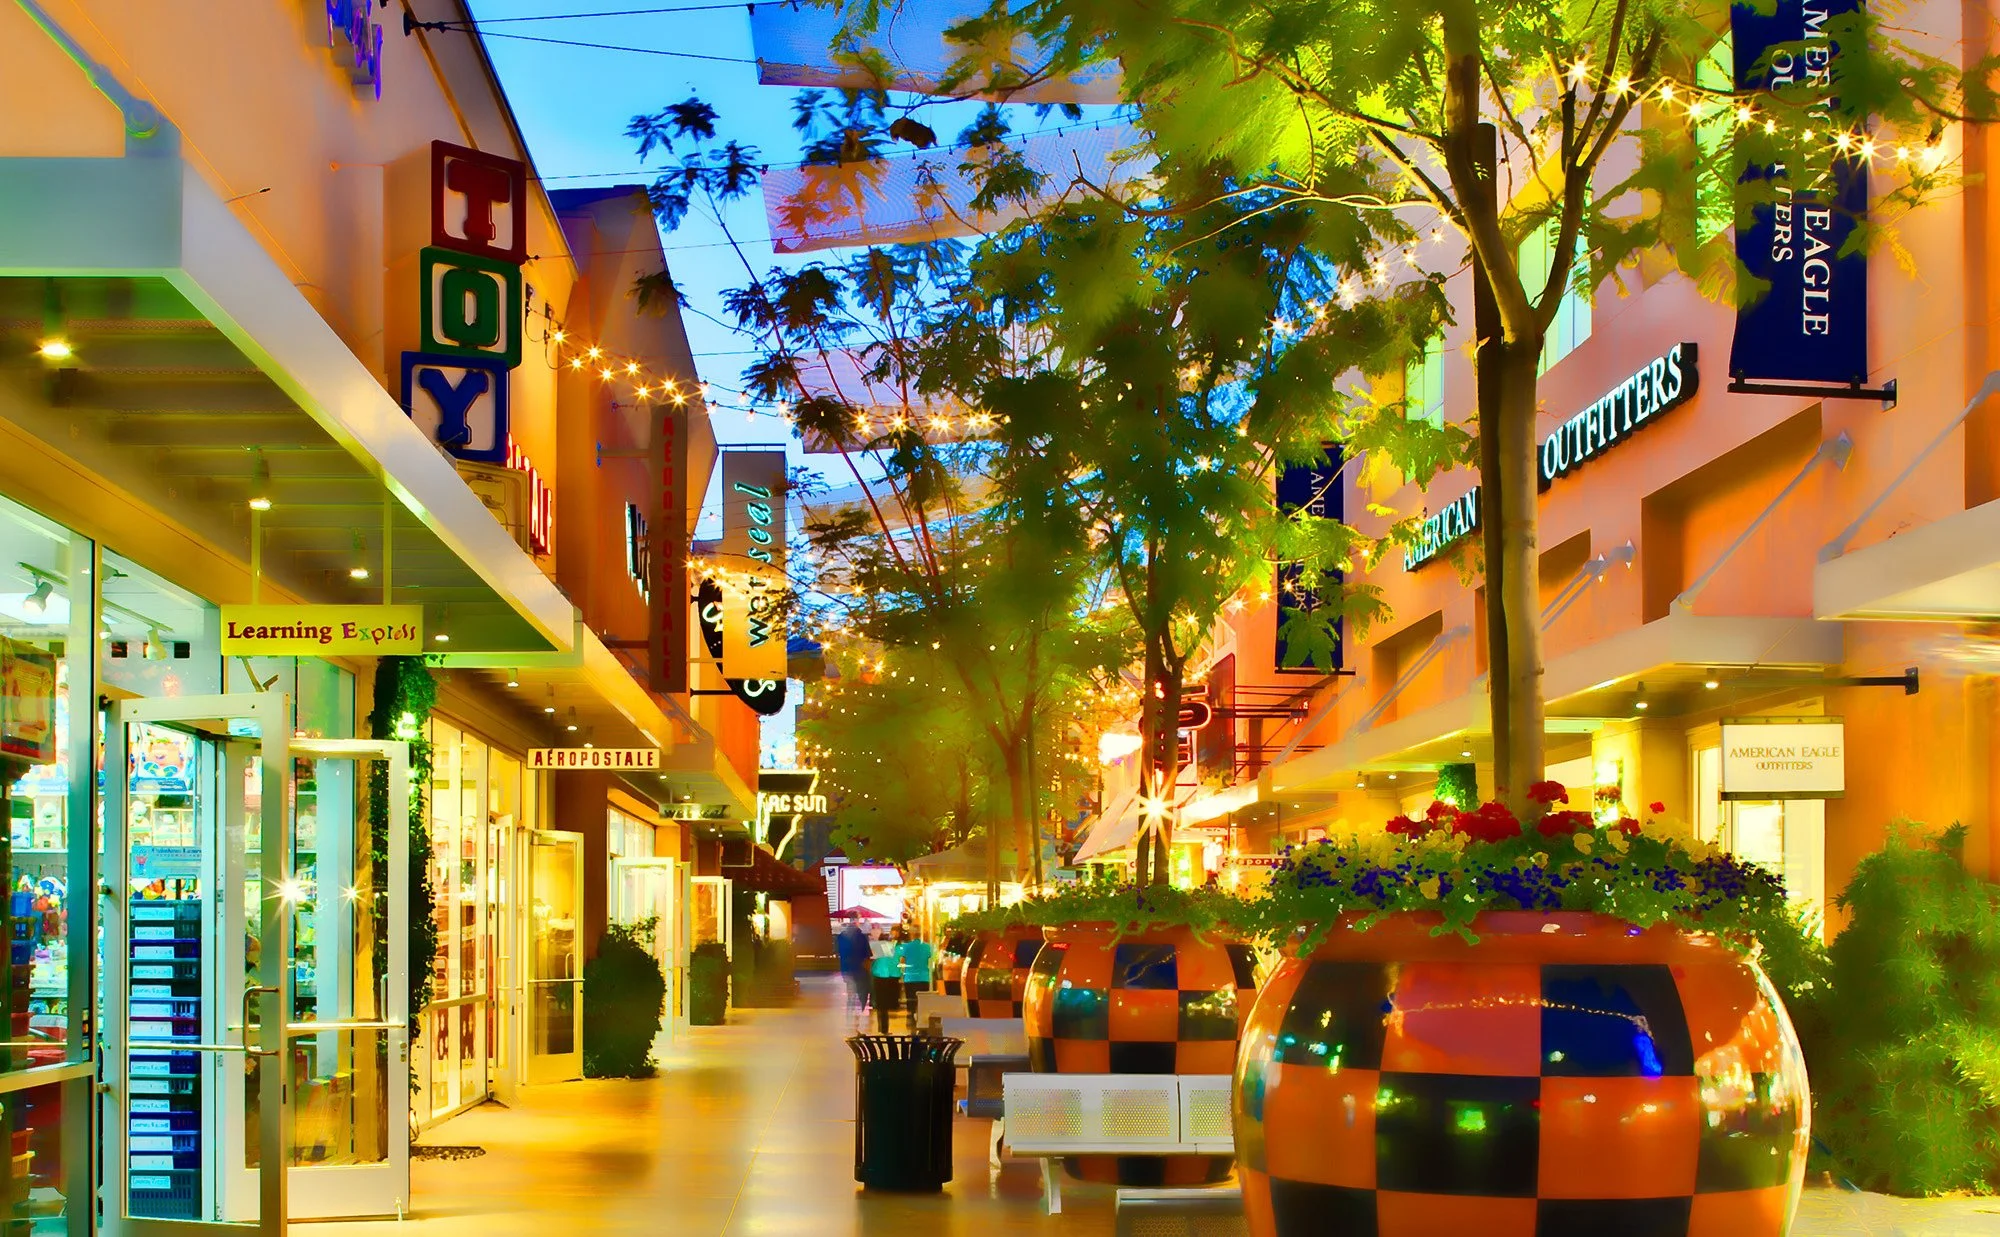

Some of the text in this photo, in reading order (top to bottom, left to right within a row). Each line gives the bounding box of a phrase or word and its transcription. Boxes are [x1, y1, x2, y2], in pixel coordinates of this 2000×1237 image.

[1802, 207, 1831, 336] EAGLE
[1543, 342, 1682, 480] OUTFITTERS
[734, 481, 772, 564] seal
[227, 620, 417, 645] Learning Express
[534, 749, 654, 767] AÉROPOSTALE
[1729, 746, 1840, 758] AMERICAN EAGLE
[1755, 761, 1813, 770] OUTFITTERS
